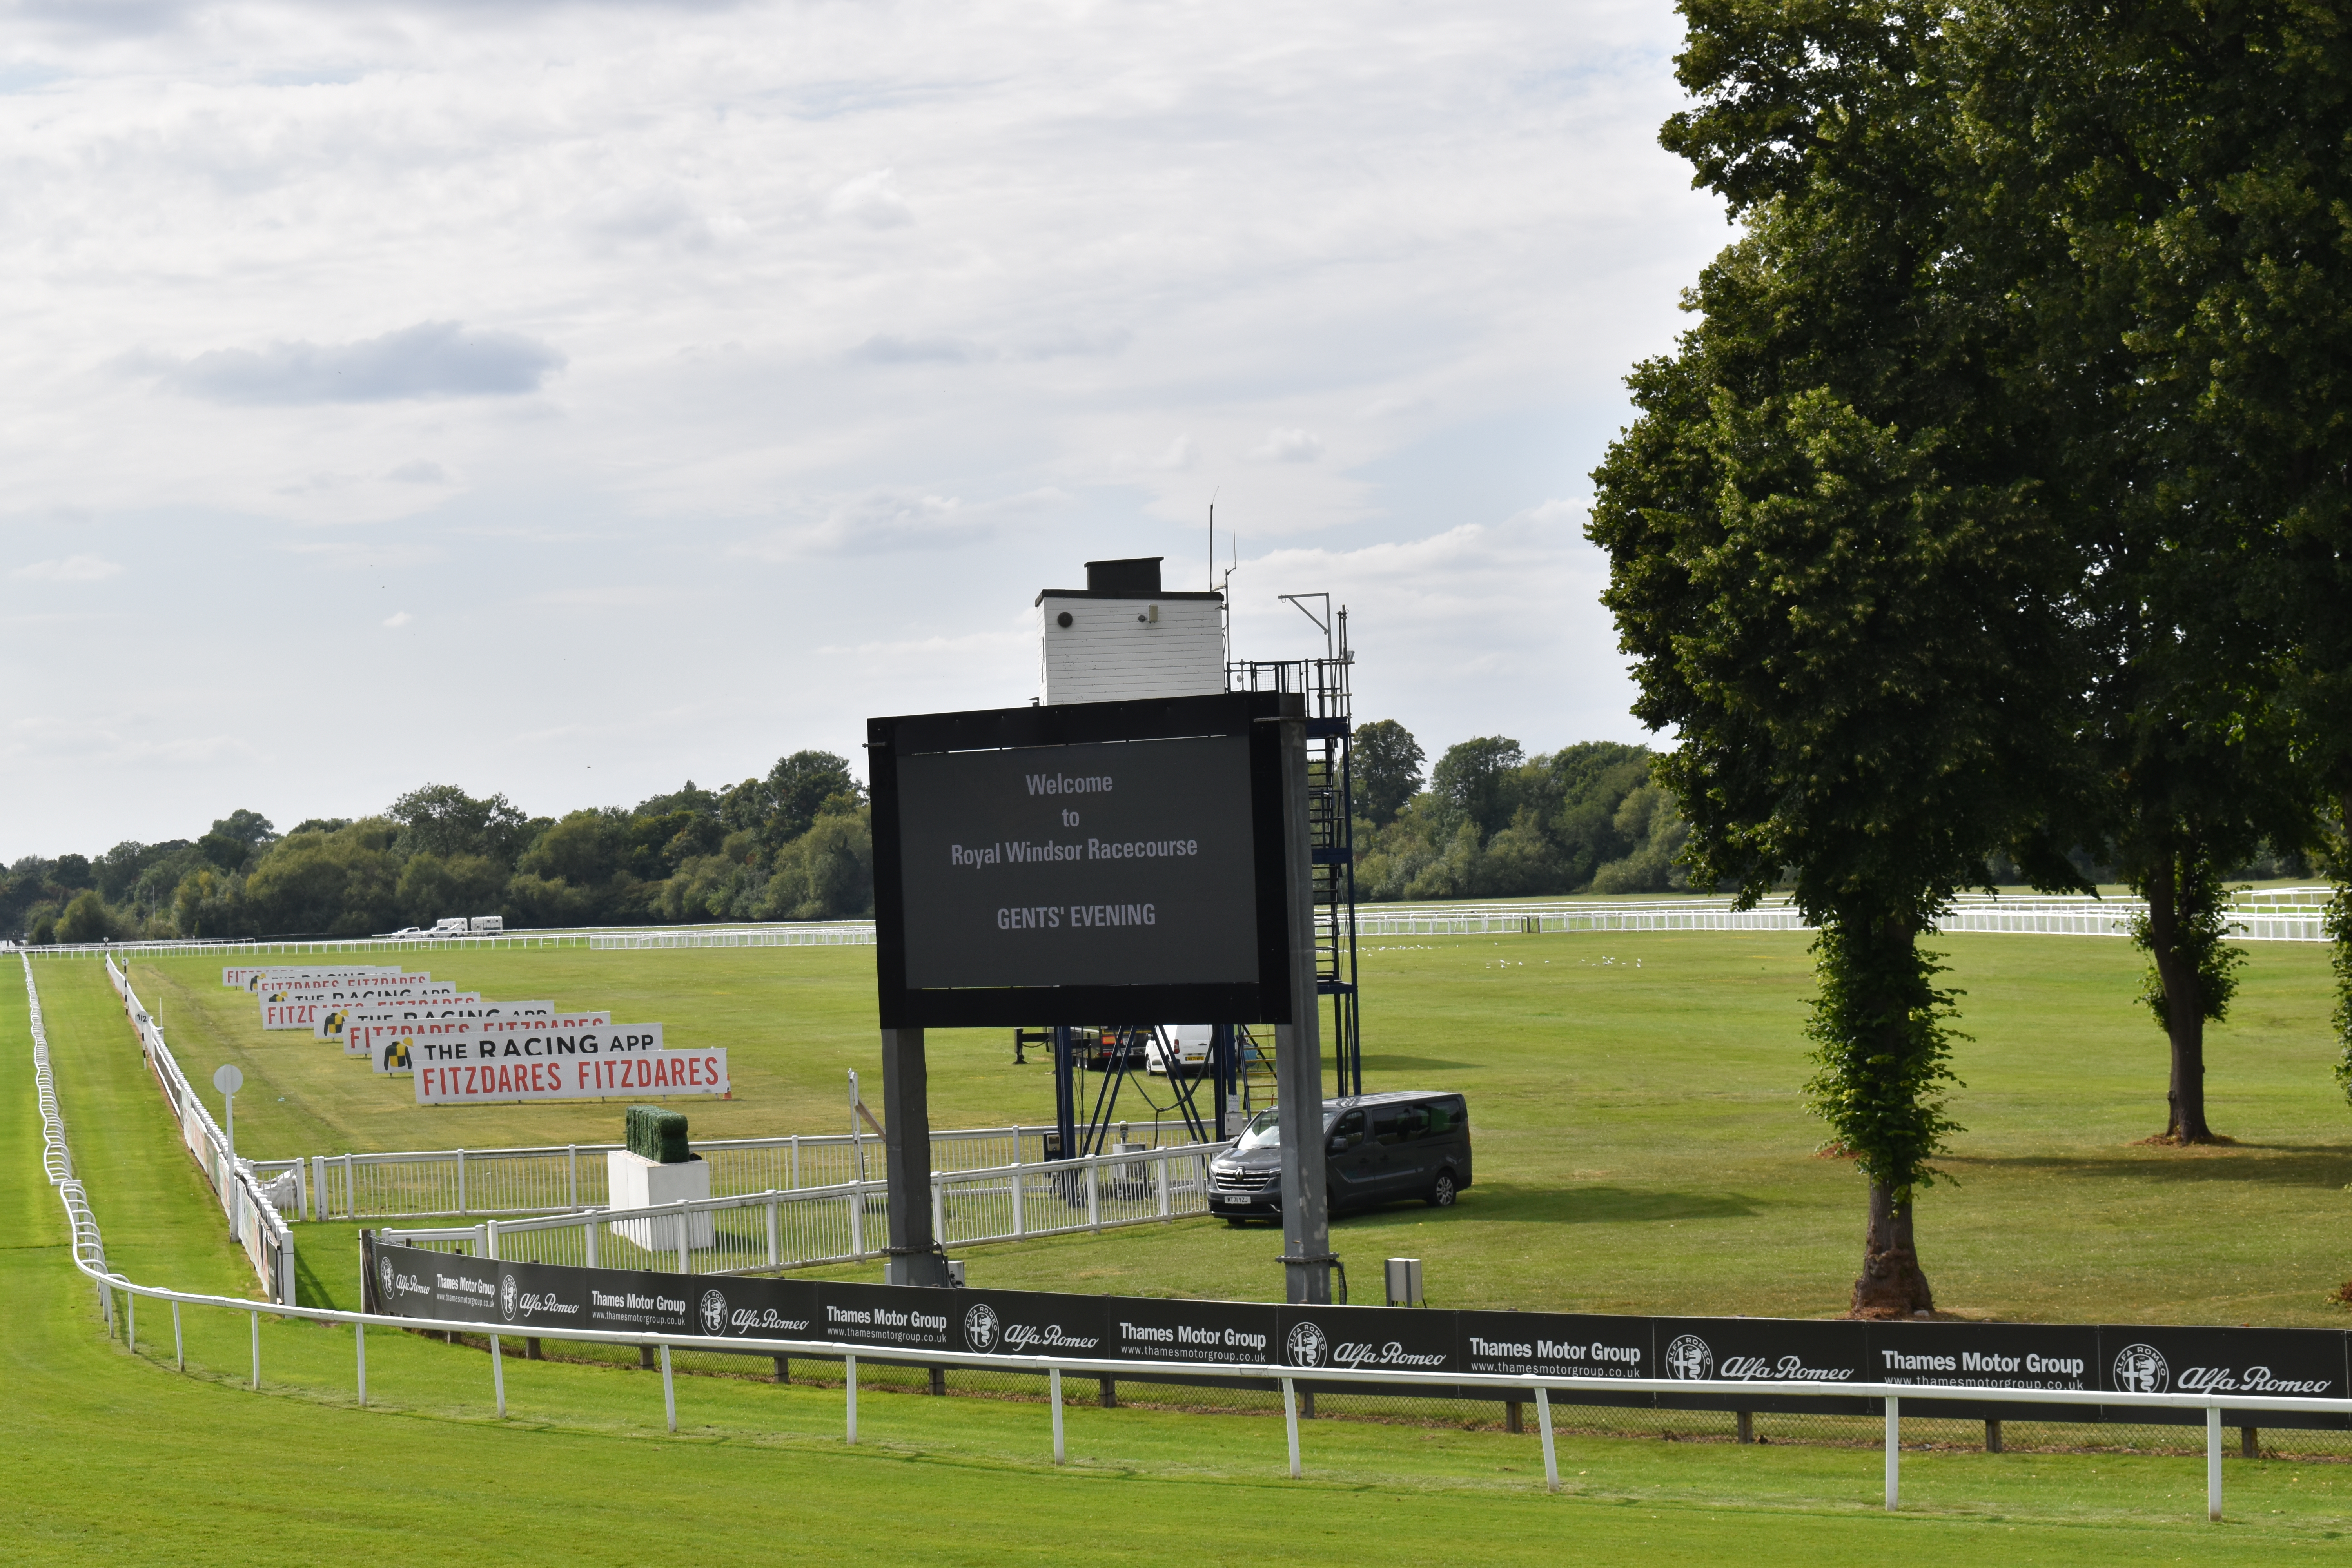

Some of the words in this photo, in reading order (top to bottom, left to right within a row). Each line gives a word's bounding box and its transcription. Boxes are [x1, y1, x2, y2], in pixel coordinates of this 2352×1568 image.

[1025, 773, 1112, 795] Welcome
[1062, 808, 1080, 827] to
[951, 843, 1000, 869] Royal
[1005, 840, 1083, 863] Windsor
[1088, 838, 1198, 859] Racecourse
[997, 906, 1064, 929] GENTS'
[1071, 903, 1155, 927] EVENING
[136, 1013, 147, 1022] 1/2
[424, 1044, 468, 1060] THE
[479, 1034, 598, 1058] RACING
[610, 1034, 654, 1052] APP
[423, 1062, 562, 1096] FITZDARES
[578, 1056, 719, 1089] FITZDARES
[396, 1274, 410, 1296] Alfa
[410, 1275, 430, 1295] Romeo
[437, 1273, 459, 1290] Thames
[460, 1276, 477, 1292] Motor
[478, 1279, 495, 1298] Group
[437, 1293, 494, 1308] www.thamesmotorgroup.co.uk
[519, 1293, 543, 1317] Alfa
[543, 1293, 579, 1314] Romeo
[592, 1290, 624, 1308] Thames
[627, 1293, 654, 1310] Motor
[657, 1295, 686, 1315] Group
[702, 1294, 710, 1313] ALFA
[712, 1292, 726, 1315] ROMEO
[592, 1311, 685, 1325] www.thamesmotorgroup.co.uk
[731, 1308, 762, 1334] Alfa
[761, 1308, 809, 1330] Romeo
[826, 1305, 871, 1324] Thames
[874, 1308, 908, 1326] Motor
[911, 1311, 947, 1332] Group
[966, 1309, 977, 1329] ALFA
[980, 1307, 997, 1331] ROMEO
[827, 1327, 946, 1343] www.thamesmotorgroup.co.uk
[1004, 1325, 1043, 1352] Alfa
[1042, 1325, 1099, 1348] Romeo
[1120, 1322, 1174, 1342] Thames
[1178, 1326, 1221, 1345] Motor
[1224, 1328, 1266, 1351] Group
[1289, 1327, 1301, 1349] ALFA
[1304, 1325, 1325, 1350] ROMEO
[1121, 1345, 1265, 1362] www.thamesmotorgroup.co.uk
[1334, 1343, 1379, 1368] Alfa
[1379, 1342, 1446, 1365] Romeo
[1470, 1338, 1532, 1357] Thames
[1537, 1340, 1586, 1359] Motor
[1591, 1342, 1641, 1366] Group
[1668, 1340, 1683, 1363] ALFA
[1686, 1338, 1711, 1365] ROMEO
[1882, 1350, 1956, 1371] Thames
[1962, 1352, 2020, 1372] Motor
[2026, 1353, 2084, 1378] Group
[2116, 1350, 2133, 1374] ALFA
[2137, 1347, 2166, 1376] ROMEO
[1471, 1362, 1640, 1377] www.thamesmotorgroup.co.uk
[1721, 1357, 1774, 1381] Alfa
[1774, 1356, 1854, 1380] Romeo
[2178, 1368, 2239, 1393] Alfa
[2239, 1366, 2332, 1392] Romeo
[1884, 1376, 2084, 1390] www.thamesmotorgroup.co.uk
